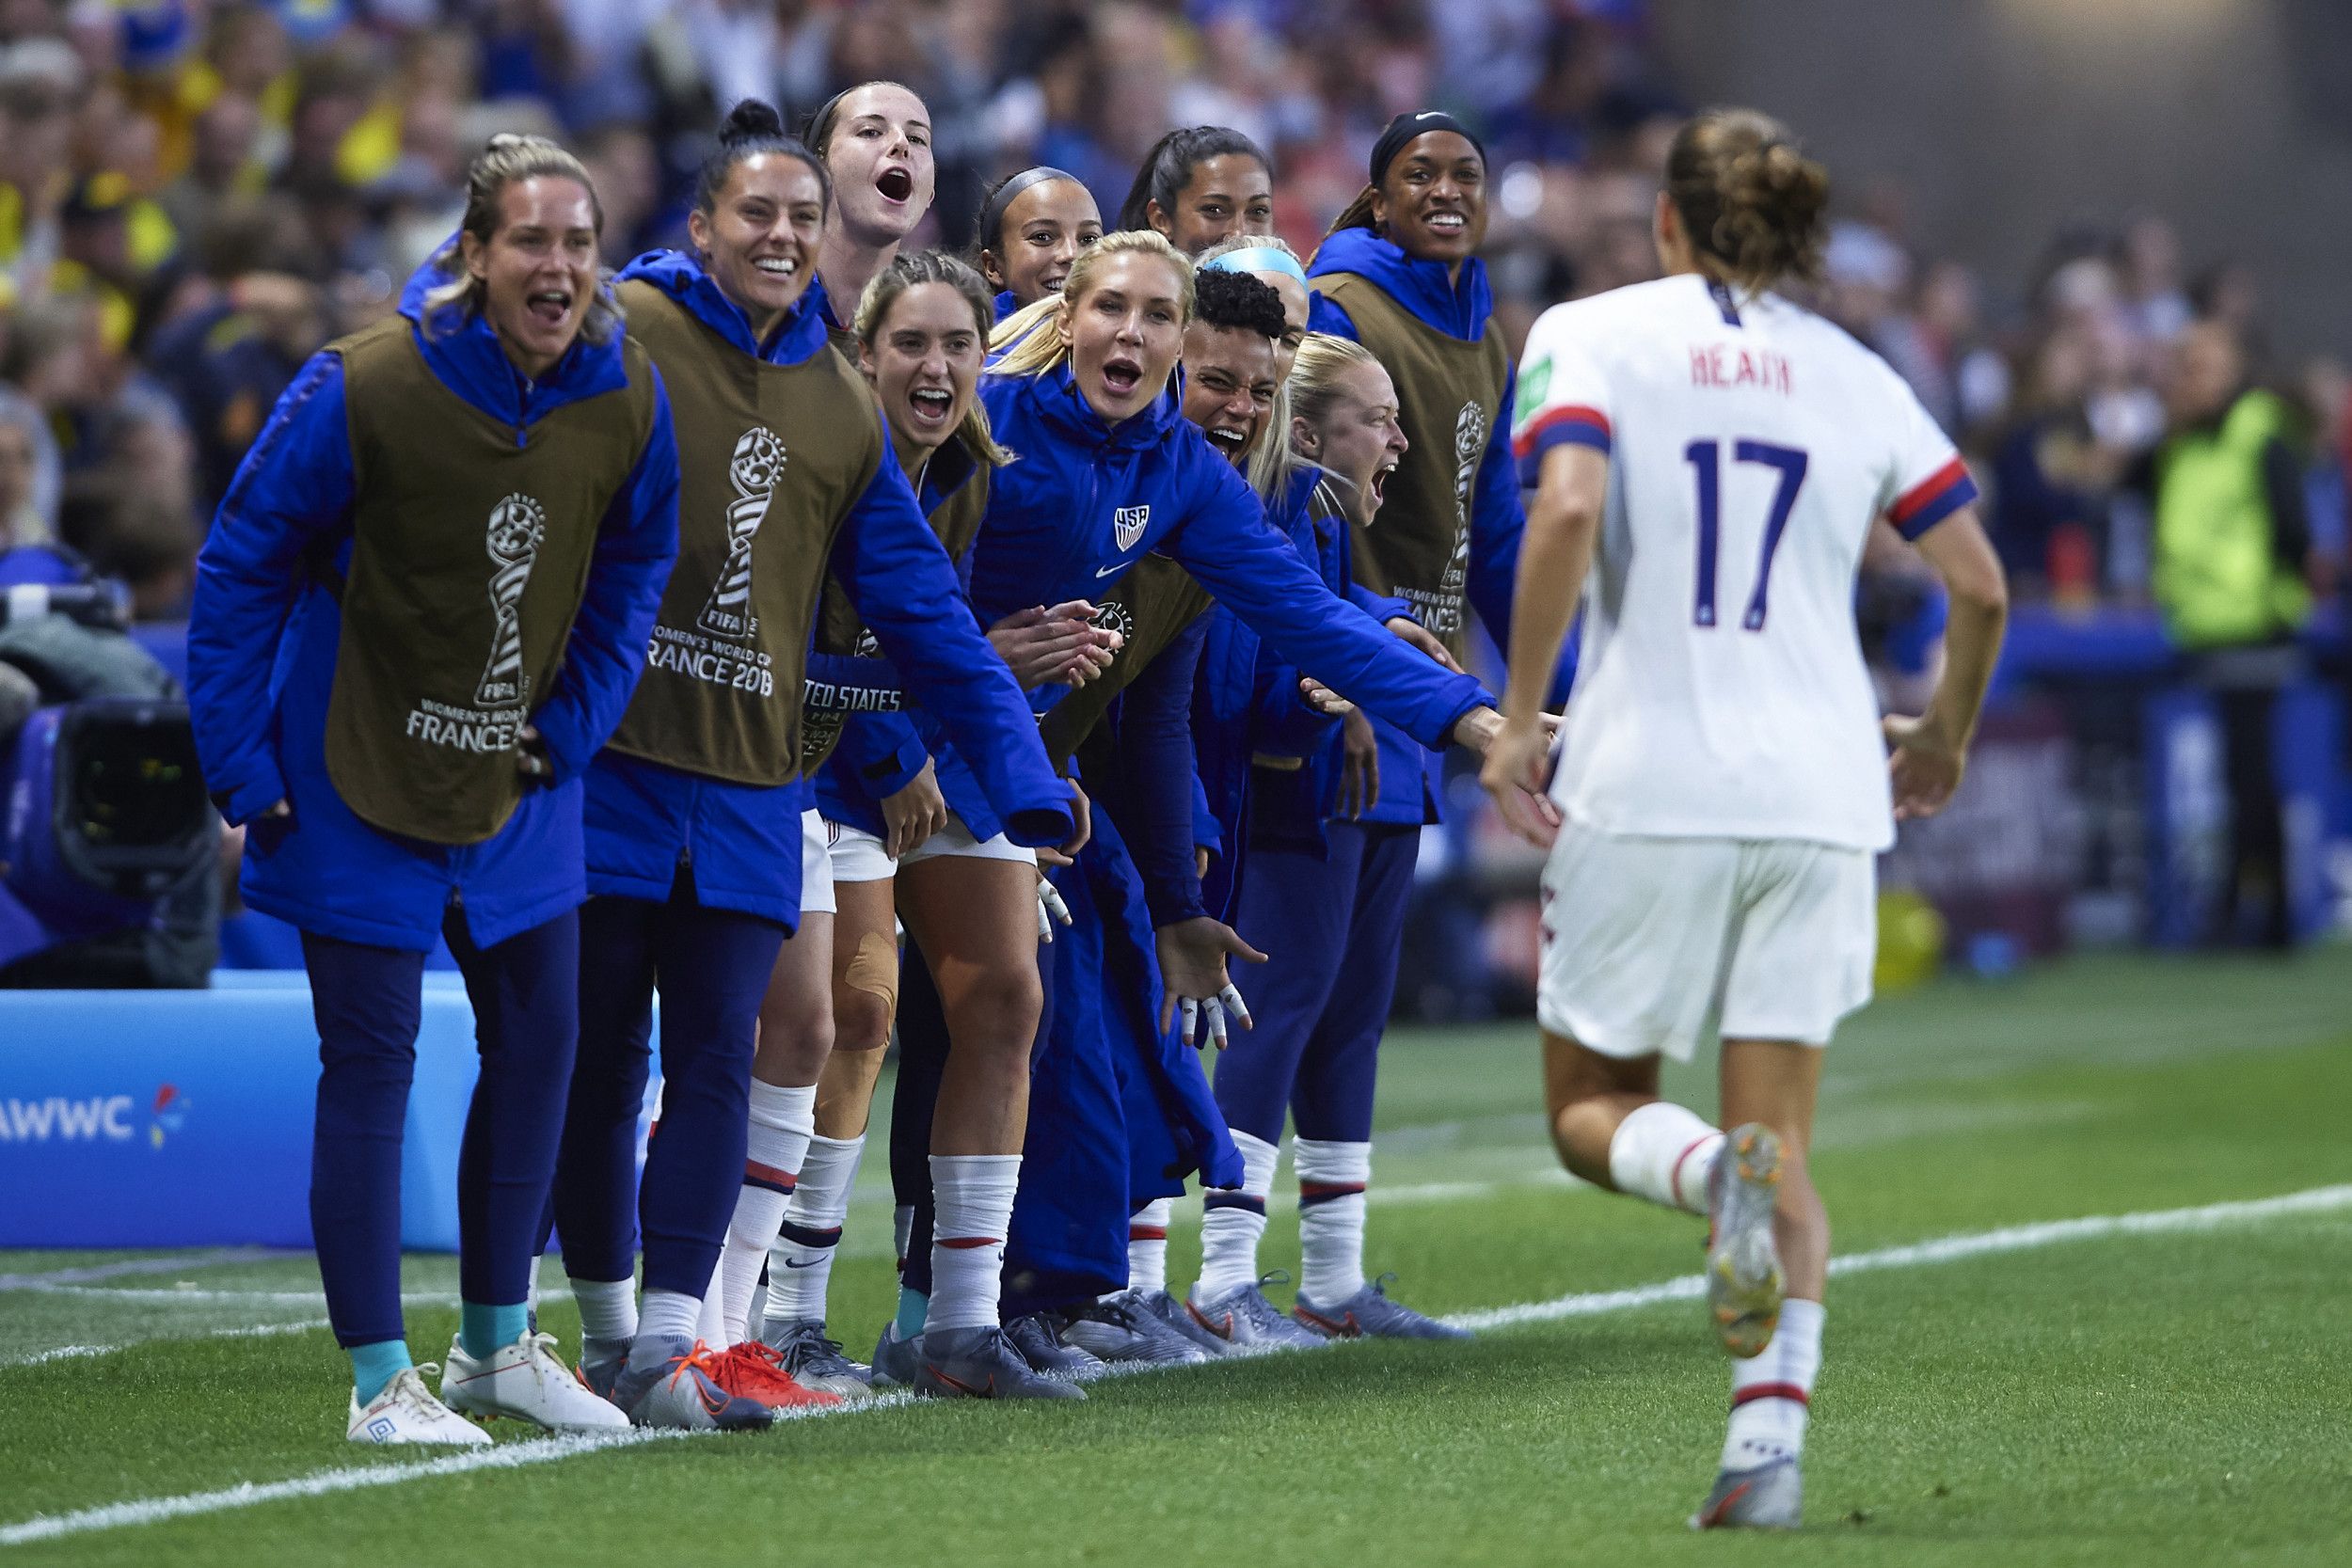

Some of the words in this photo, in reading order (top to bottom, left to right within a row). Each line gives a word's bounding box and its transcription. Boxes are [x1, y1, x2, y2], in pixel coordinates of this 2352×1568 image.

[1689, 342, 1793, 396] HEATH
[1116, 508, 1148, 528] USA
[1683, 437, 1808, 632] 17
[707, 610, 741, 632] FIFA
[1412, 604, 1456, 632] ANCE
[647, 639, 732, 684] RANCE
[653, 625, 709, 650] OMEN'S
[712, 640, 755, 662] WORLD
[803, 678, 835, 707] TED
[837, 686, 901, 712] STATES
[406, 709, 514, 753] FRANCE
